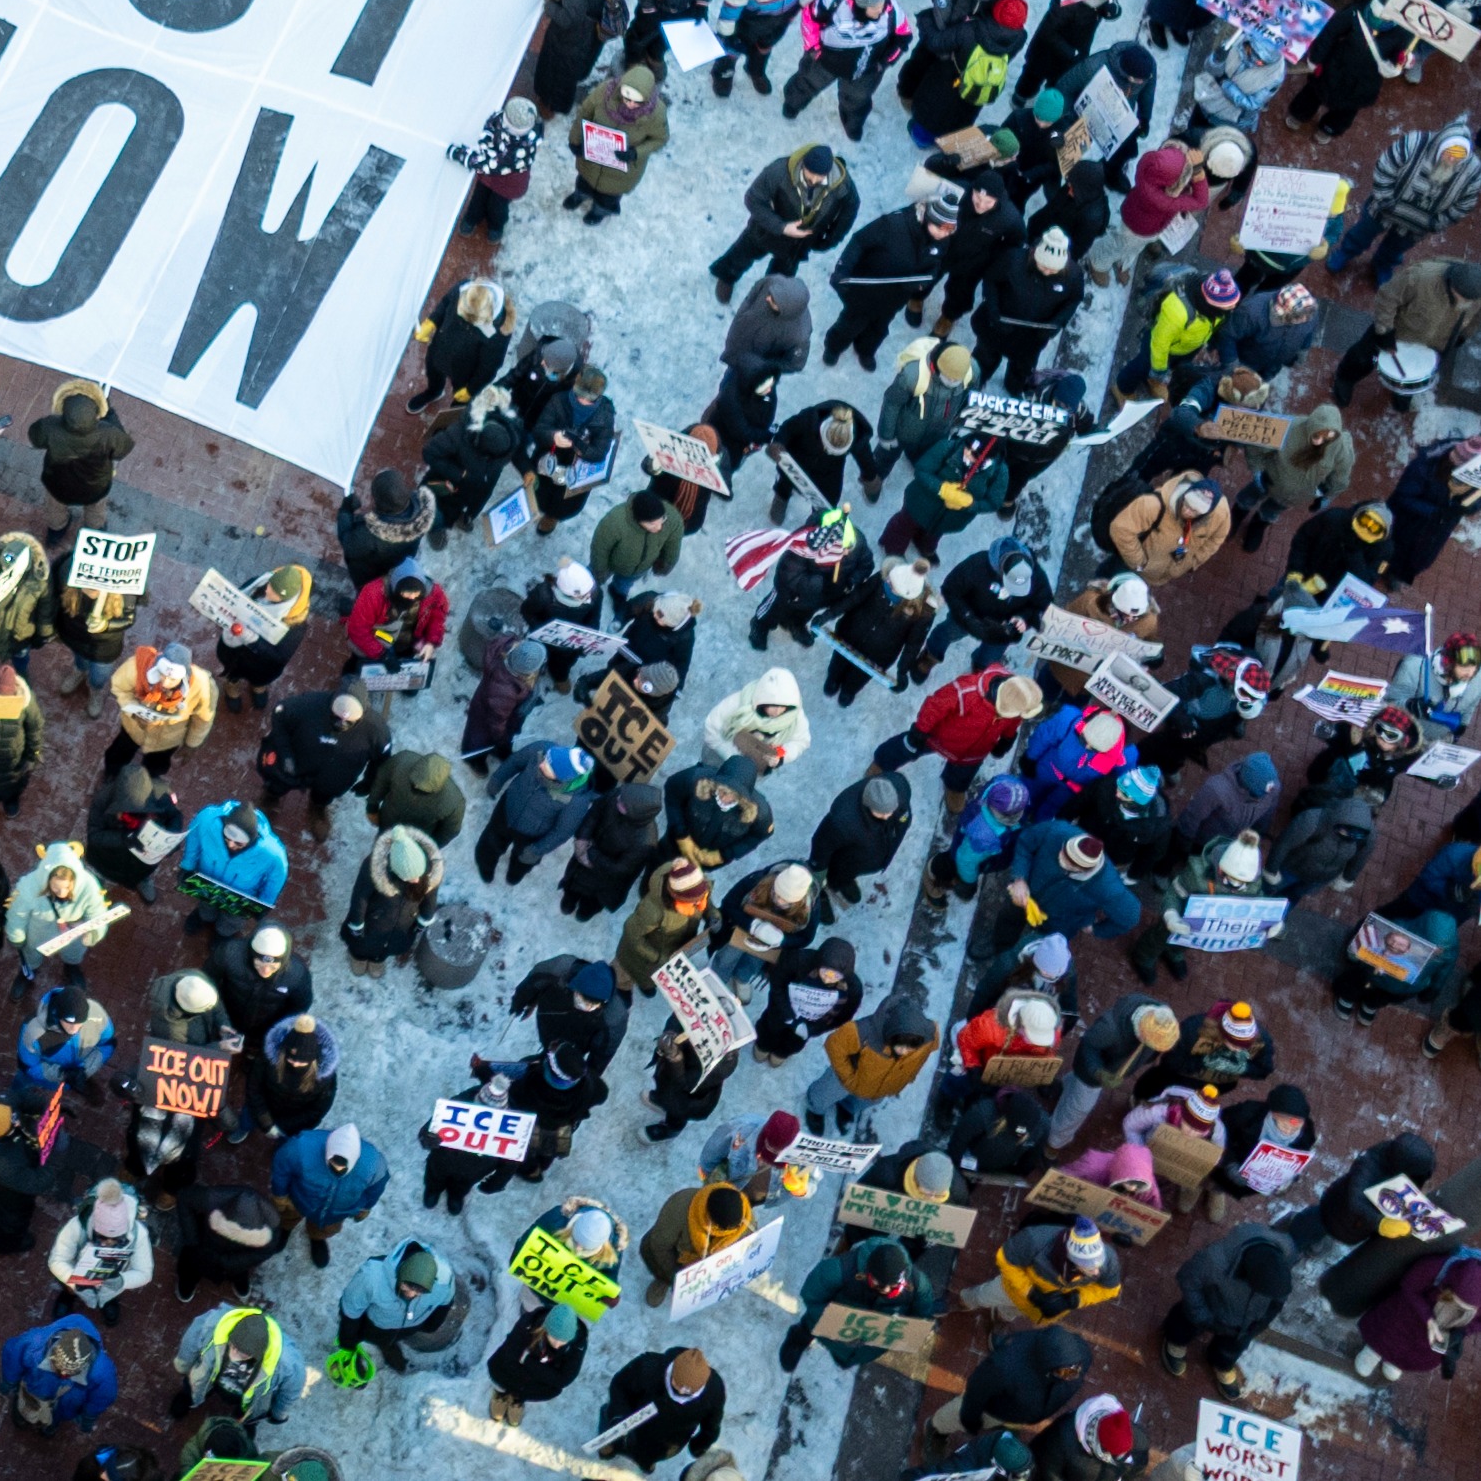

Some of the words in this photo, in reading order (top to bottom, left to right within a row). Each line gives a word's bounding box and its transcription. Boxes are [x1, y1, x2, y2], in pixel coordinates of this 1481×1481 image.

[969, 391, 1005, 410] FUCK
[1221, 420, 1277, 437] PRETTI
[1225, 430, 1271, 445] GOOD
[83, 535, 149, 563] STOP
[75, 572, 140, 585] NOW!
[78, 562, 96, 575] ICE
[98, 564, 142, 577] TERROR
[1049, 607, 1077, 628] WE
[1026, 635, 1090, 665] DEPORT
[1089, 680, 1117, 704] ALEX
[1113, 696, 1154, 727] PRETTI
[1095, 674, 1139, 707] JUSTICE
[602, 679, 669, 768] ICE
[580, 717, 650, 783] OUT
[1186, 899, 1285, 919] Freeze
[1207, 918, 1258, 935] Their
[670, 956, 710, 1007] Hey
[656, 970, 705, 1035] BOOT
[147, 1045, 187, 1077] ICE
[188, 1055, 229, 1086] OUT
[997, 1060, 1057, 1073] TRUMP
[156, 1077, 222, 1118] NOW!
[442, 1105, 521, 1136] ICE
[437, 1127, 518, 1155] OUT
[1052, 1174, 1080, 1188] Say
[843, 1201, 928, 1226] IMMIGRANT
[849, 1186, 876, 1202] WE
[905, 1201, 940, 1218] OUR
[1044, 1183, 1084, 1200] Their
[1107, 1196, 1162, 1226] Renee
[1095, 1210, 1144, 1238] Alex
[523, 1254, 582, 1294] OUT
[537, 1235, 609, 1287] ICE
[714, 1253, 734, 1267] on
[515, 1267, 563, 1299] MN
[838, 1326, 904, 1345] OUT
[843, 1312, 909, 1334] ICE
[1216, 1412, 1285, 1455] ICE
[1204, 1438, 1291, 1479] WORST
